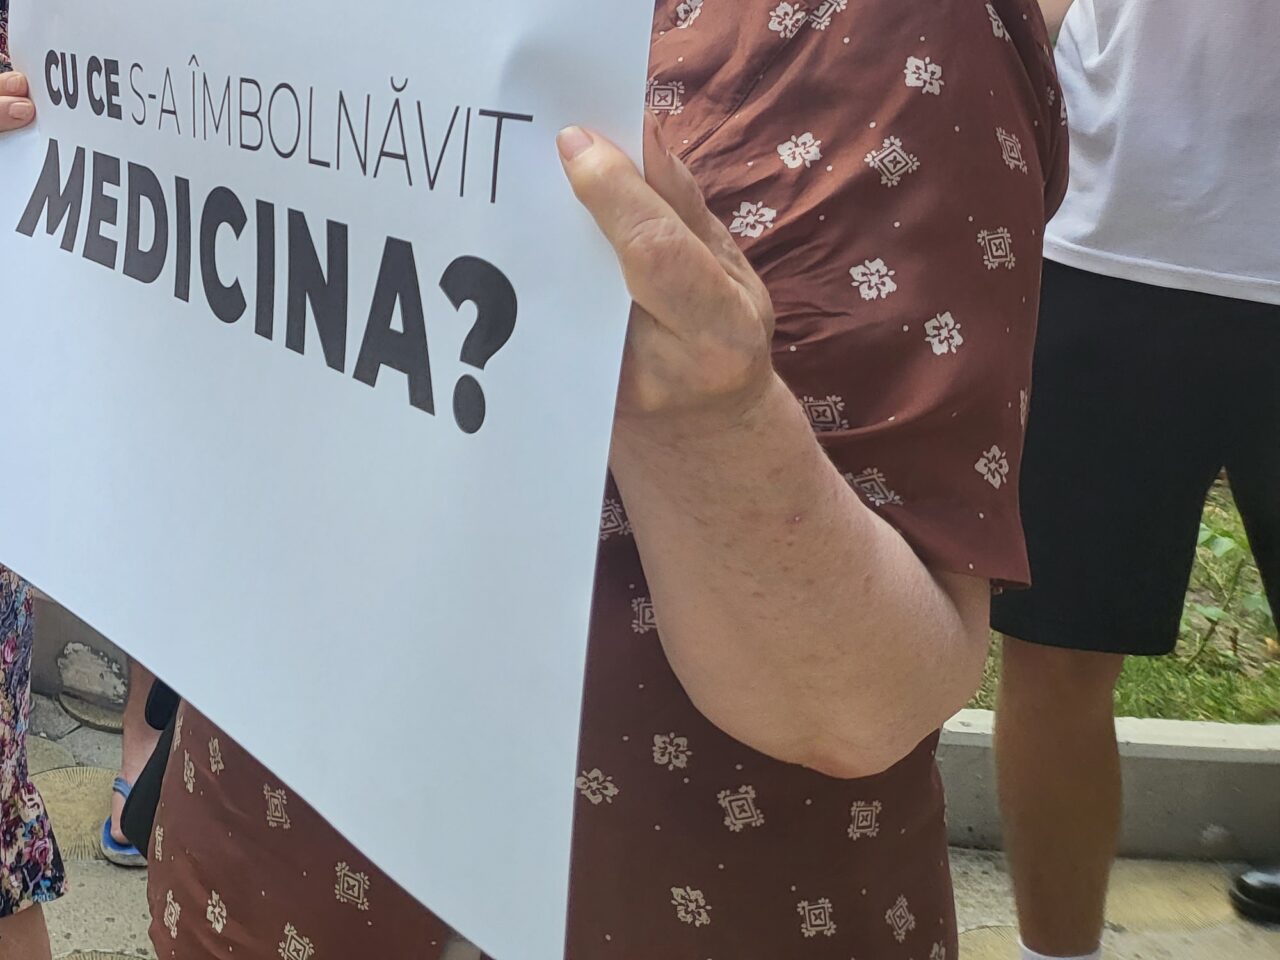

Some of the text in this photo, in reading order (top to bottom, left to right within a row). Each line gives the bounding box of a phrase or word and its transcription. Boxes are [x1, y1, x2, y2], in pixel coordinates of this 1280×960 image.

[45, 49, 534, 204] CU CE S-A ÎMBOLNĂVIT
[15, 138, 518, 435] MEDICINA?
